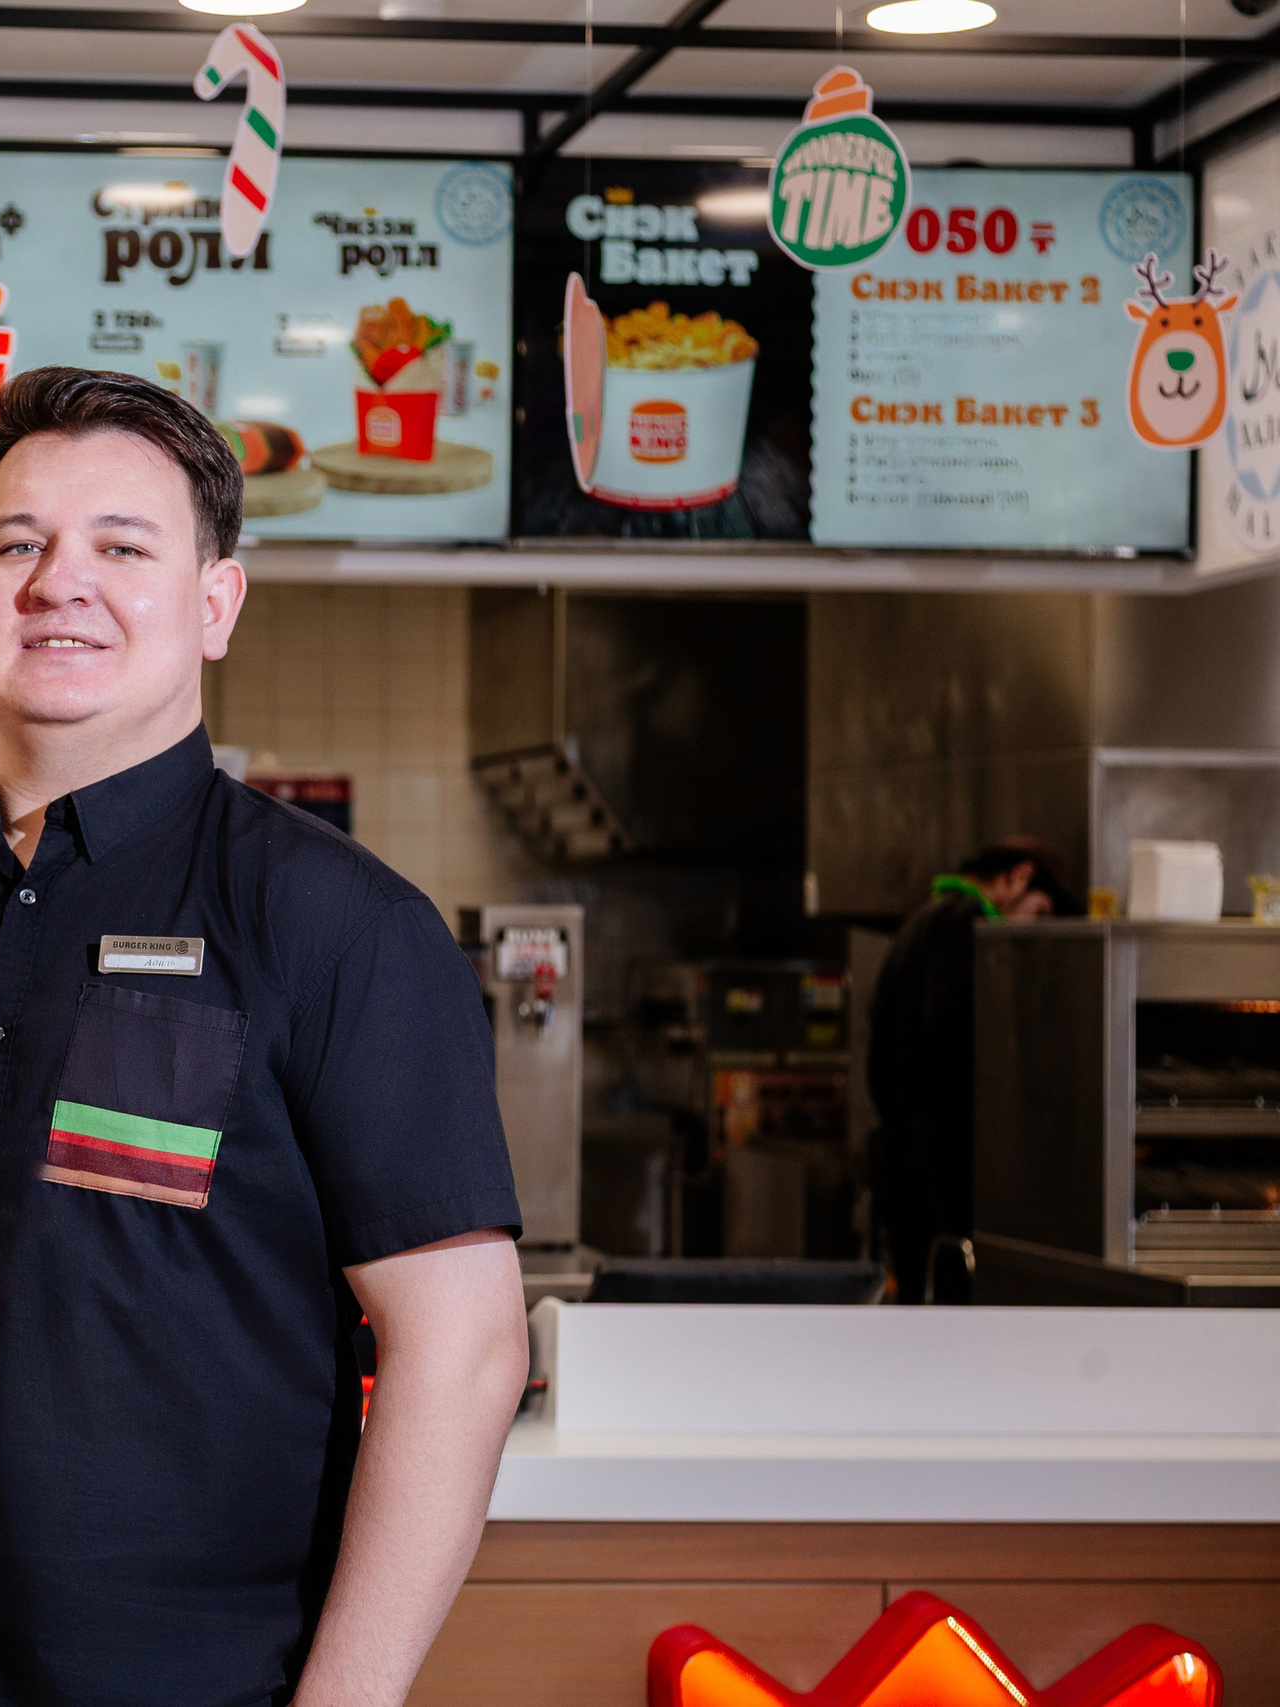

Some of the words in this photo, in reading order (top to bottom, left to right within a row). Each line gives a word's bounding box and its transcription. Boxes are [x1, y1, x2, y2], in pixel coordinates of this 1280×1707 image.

[781, 131, 898, 182] WONDERFUL
[565, 195, 700, 242] Снэк
[779, 168, 895, 250] TIME
[339, 240, 439, 276] ролл
[601, 239, 759, 286] Бакет
[849, 273, 944, 302] Снэк
[955, 273, 1070, 304] Бакет
[849, 396, 944, 425] Снэк
[955, 396, 1070, 428] Бакет
[112, 941, 148, 950] BURGER
[150, 942, 171, 951] KING
